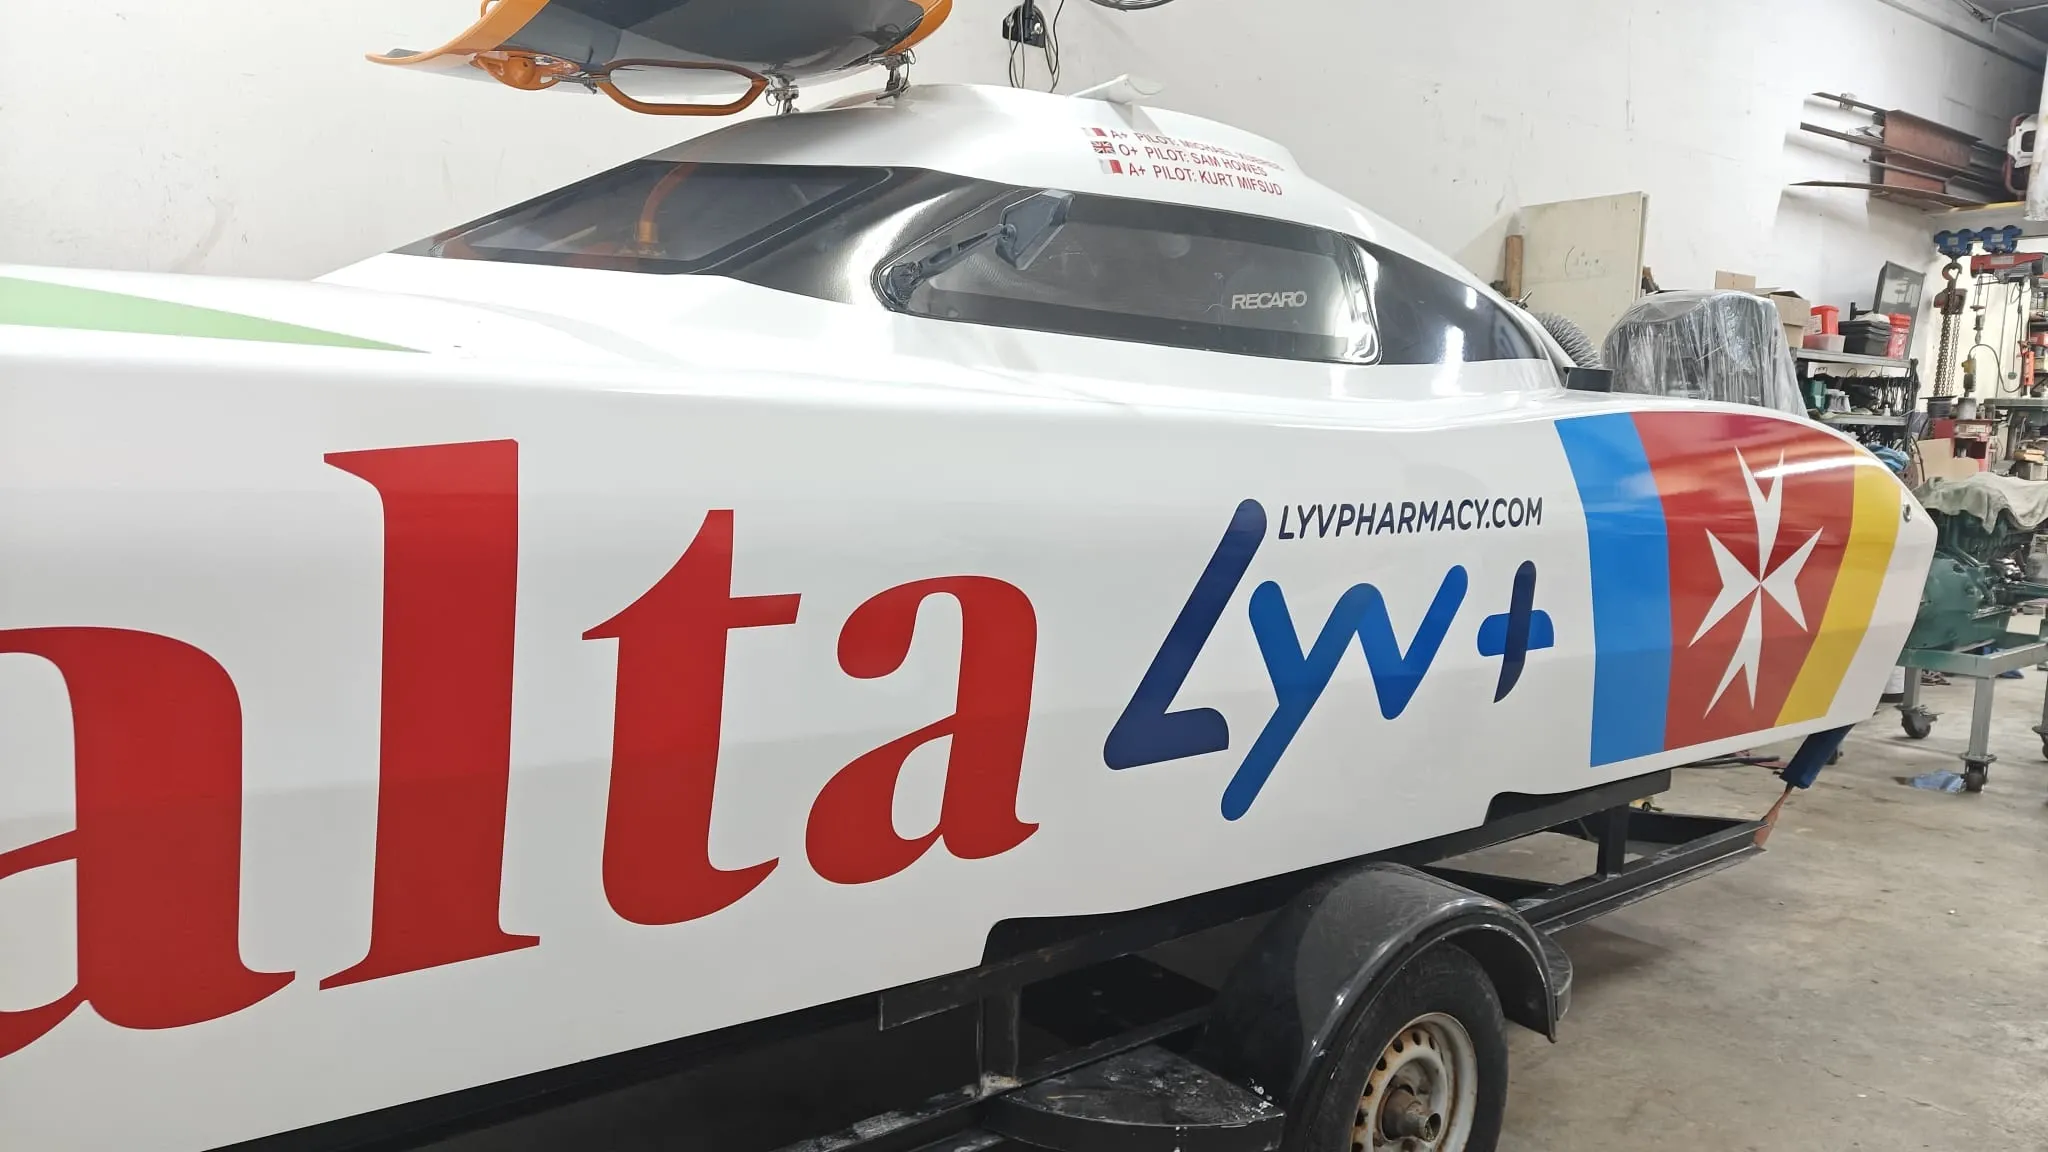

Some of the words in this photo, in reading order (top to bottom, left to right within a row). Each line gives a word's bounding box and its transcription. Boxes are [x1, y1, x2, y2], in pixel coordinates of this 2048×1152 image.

[1134, 132, 1180, 147] PILOT:
[1118, 143, 1138, 156] O+
[1144, 146, 1190, 163] PILOT:
[1190, 152, 1221, 168] SAM
[1221, 157, 1267, 177] HOWES
[1129, 162, 1146, 177] A+
[1152, 165, 1197, 183] PILOT:
[1199, 170, 1234, 188] KURT
[1237, 175, 1283, 196] MIFSUD
[1231, 291, 1308, 310] RECARO
[1278, 497, 1543, 540] LYVPHARMACY.COM
